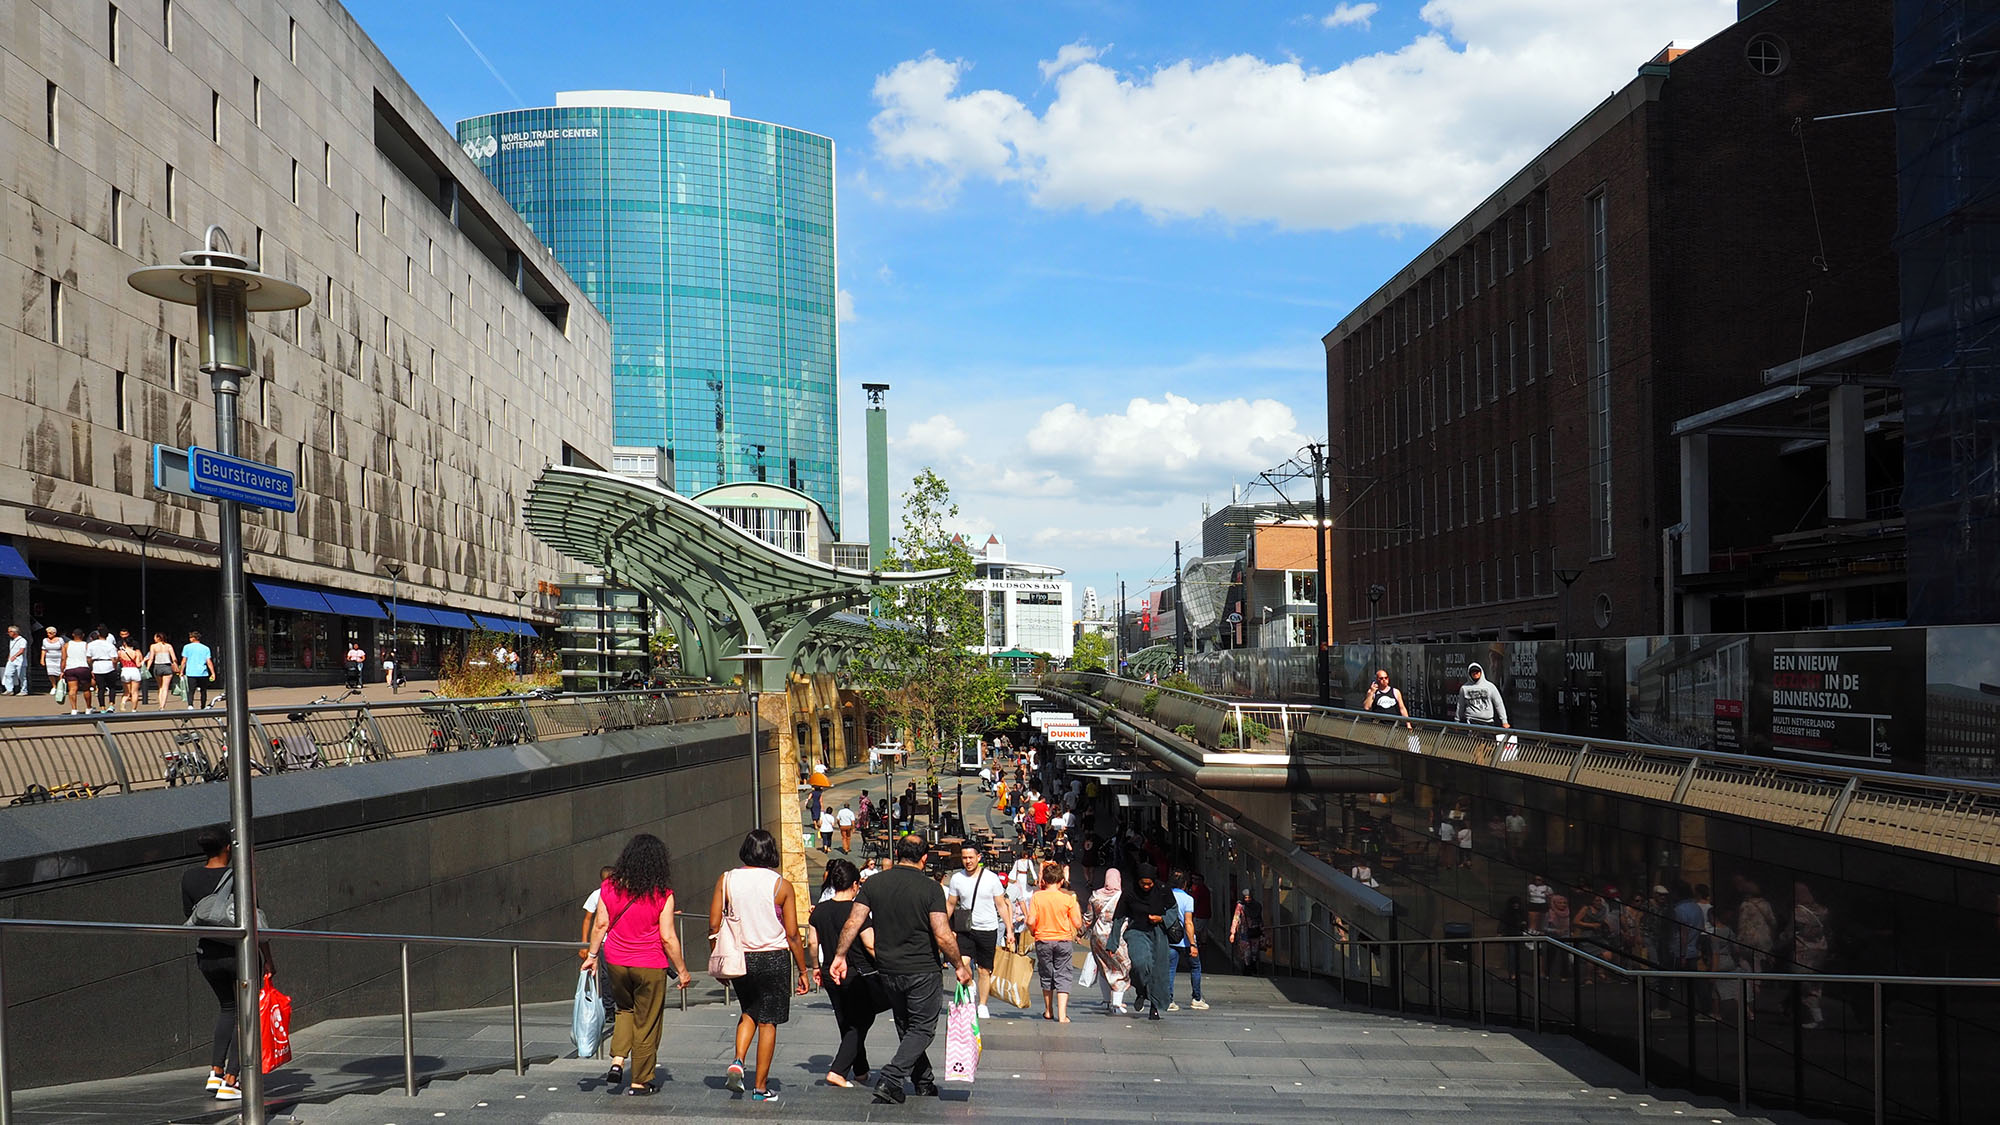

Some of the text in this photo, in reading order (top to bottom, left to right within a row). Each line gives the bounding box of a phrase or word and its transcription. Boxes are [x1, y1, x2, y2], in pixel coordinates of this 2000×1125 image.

[501, 128, 598, 142] WORLD TRADE CENTER
[501, 140, 545, 151] ROTTERDAM
[202, 457, 288, 493] Beurstraverse
[1773, 655, 1839, 671] EEN NIEUW
[1825, 674, 1840, 690] IN
[1843, 674, 1860, 691] DE
[1773, 690, 1852, 709] BINNENSTAD.
[1772, 716, 1836, 729] MULTI NETHERLANDS
[1772, 725, 1821, 738] REALISEERT HIER
